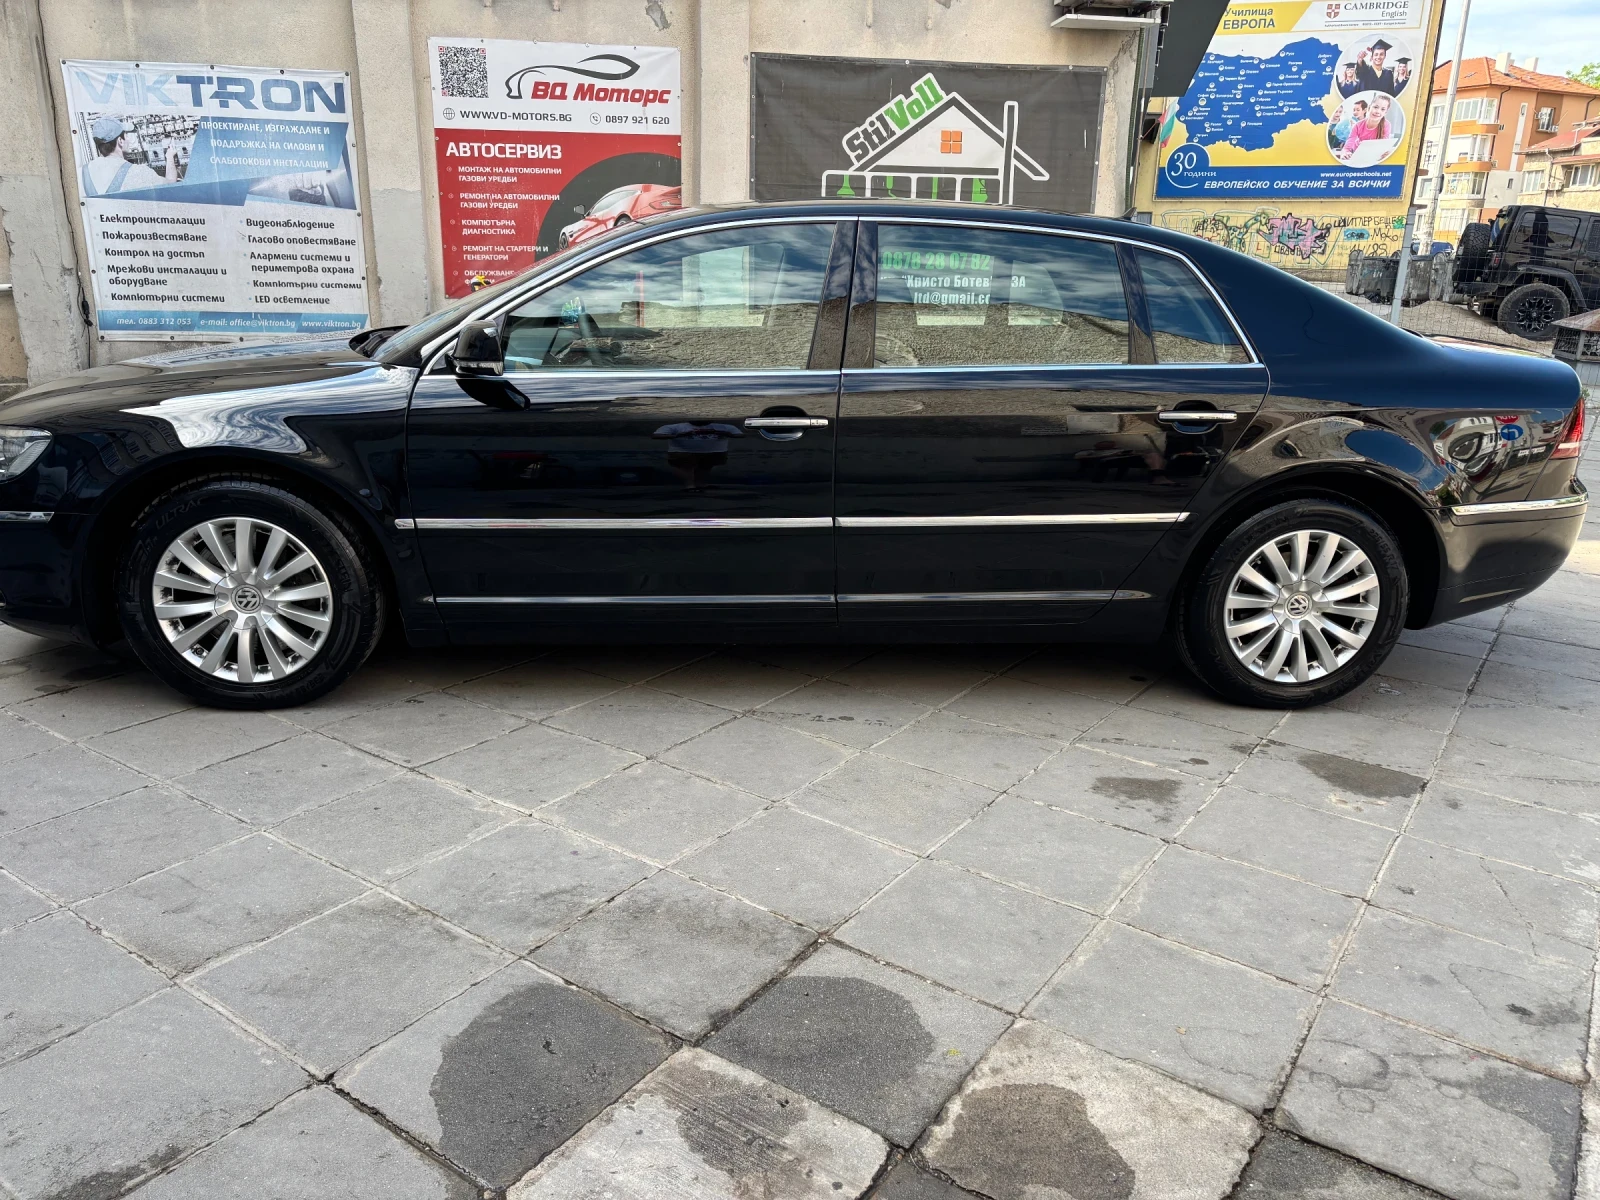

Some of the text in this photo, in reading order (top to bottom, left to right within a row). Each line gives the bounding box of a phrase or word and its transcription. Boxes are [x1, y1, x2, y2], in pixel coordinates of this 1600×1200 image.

[1344, 0, 1409, 10] CAMBRIDGE
[1225, 8, 1274, 17] Училища
[1381, 10, 1407, 18] English
[1223, 18, 1276, 30] ЕВРОПА
[75, 71, 346, 114] VIKTRON
[531, 81, 671, 107] ВД Моторс
[460, 110, 572, 122] WWW.VD-MOTORS.BG
[605, 115, 670, 125] 0897 921 620
[845, 76, 944, 163] StilVoll
[200, 121, 330, 135] ПРОЕКТИРАНЕ, ИЗГРАЖДАНЕ И
[210, 139, 267, 150] ПОДДРЪЖКА
[269, 141, 280, 150] НА
[283, 142, 316, 151] СИЛОВИ
[446, 142, 562, 160] АВТОСЕРВИЗ
[210, 156, 329, 169] СЛАБОТОКОВИ ИНСТАЛАЦИИ
[1171, 152, 1197, 176] 30
[458, 166, 562, 175] МОНТАЖ НА АВТОМОБИЛНИ
[488, 176, 518, 184] УРЕДБИ
[1204, 179, 1391, 189] ЕВРОПЕЙСКО ОБУЧЕНИЕ ЗА ВСИЧКИ
[460, 192, 491, 200] РЕМОНТ
[503, 193, 560, 201] АВТОМОБИЛНИ
[489, 202, 518, 210] УРЕДБИ
[100, 214, 206, 226] Електроинсталации
[246, 218, 335, 230] Видеонаблюдение
[102, 231, 207, 242] Пожароизвестяване
[462, 228, 516, 236] ДИАГНОСТИКА
[248, 235, 356, 246] Гласово оповестяване
[105, 248, 150, 258] Контрол
[167, 250, 205, 259] достъп
[250, 252, 297, 262] Алармени
[300, 254, 342, 262] системи
[882, 251, 991, 270] 0878 28 07 82
[107, 265, 154, 274] Мрежови
[157, 267, 218, 276] инсталации
[251, 265, 354, 275] периметрова охрана
[109, 277, 168, 287] оборудване
[253, 280, 318, 290] Компютърни
[111, 293, 179, 303] Компютърни
[255, 296, 330, 304] LED осветление
[200, 318, 296, 328] e-mail: office@viktron.bg
[302, 319, 362, 329] www.viktron.bg
